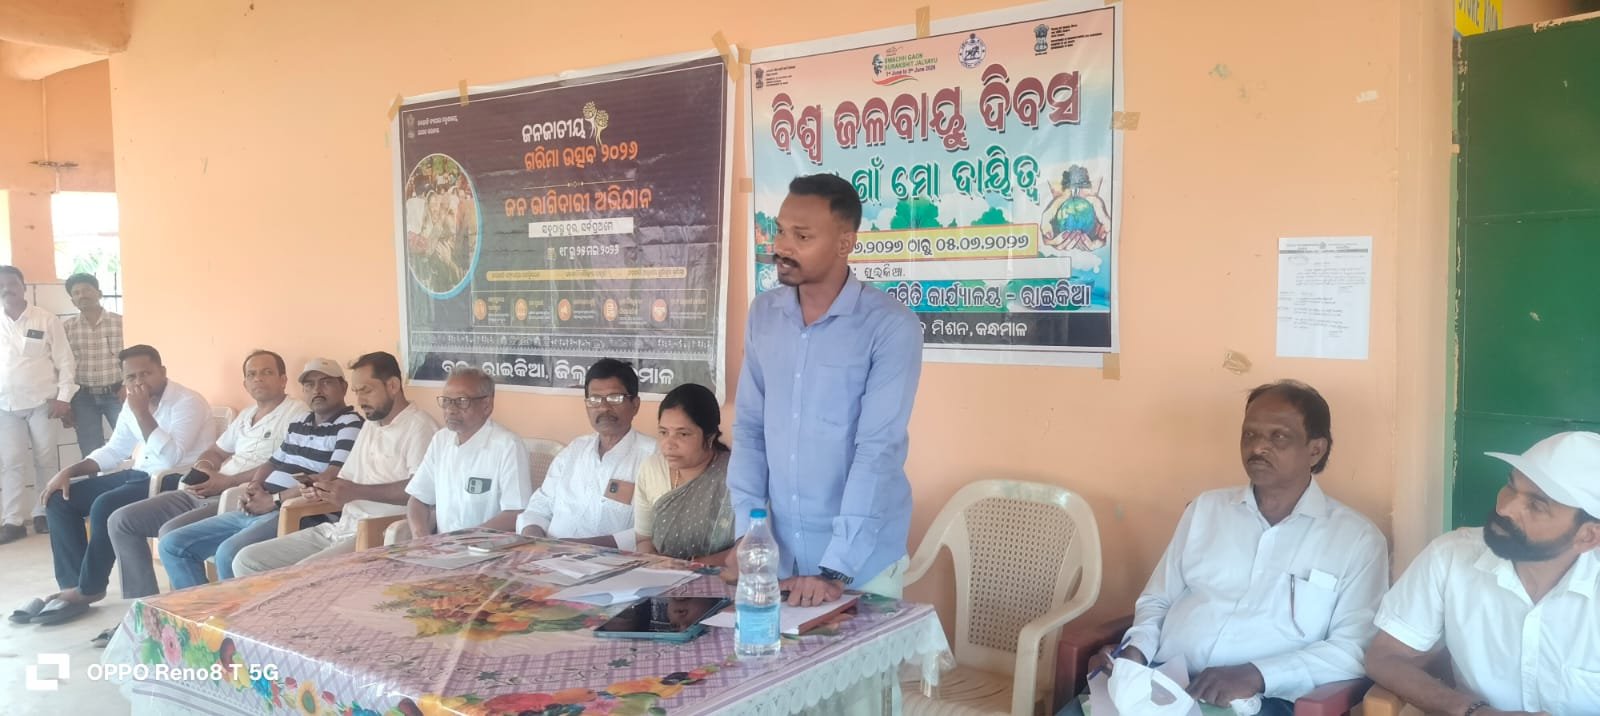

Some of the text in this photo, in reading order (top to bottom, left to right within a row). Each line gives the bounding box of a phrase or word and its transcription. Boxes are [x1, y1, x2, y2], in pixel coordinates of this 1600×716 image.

[770, 63, 1081, 166] ବିଶ୍ୱ ଜଳବାୟୁ ଦିବସ
[522, 118, 586, 143] ଜନଜାତୀୟ
[524, 140, 638, 171] ଗରିମା ଉତ୍ସବ ୨୦୨୬
[891, 162, 942, 201] ମୋ
[504, 184, 652, 218] ଜନ ଭାଗିଦାରୀ ଅଭିଯାନ
[908, 237, 932, 256] ଠାରୁ
[936, 234, 1029, 252] ୦୫.୦୬.୨୦୨୬
[1020, 279, 1092, 308] ରାଇକିଆ
